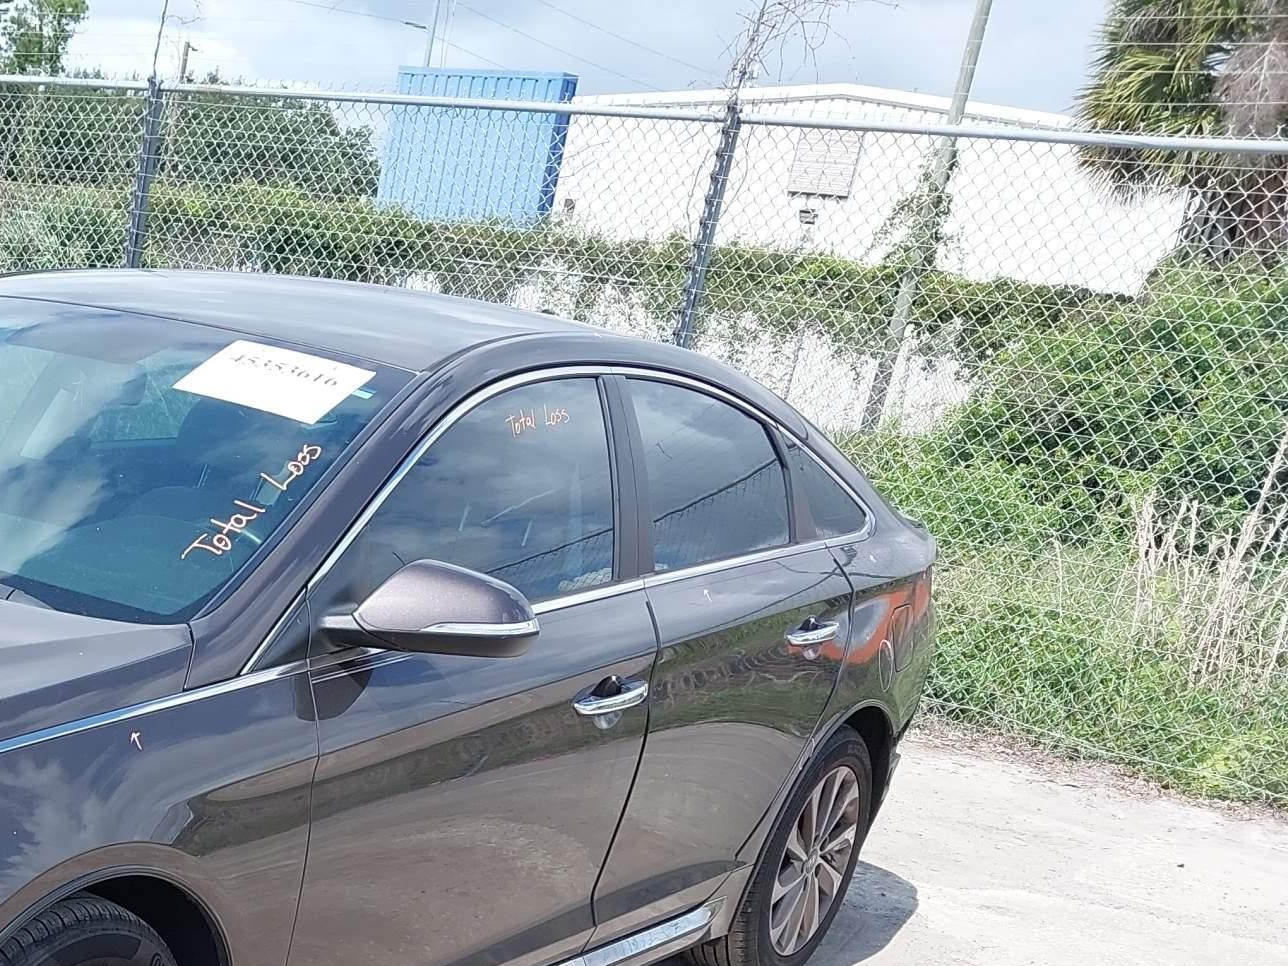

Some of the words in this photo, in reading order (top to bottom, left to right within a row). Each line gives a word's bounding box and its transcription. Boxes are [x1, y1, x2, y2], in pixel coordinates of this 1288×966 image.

[504, 408, 537, 439] Total
[543, 403, 570, 426] Loss
[181, 499, 266, 560] Total
